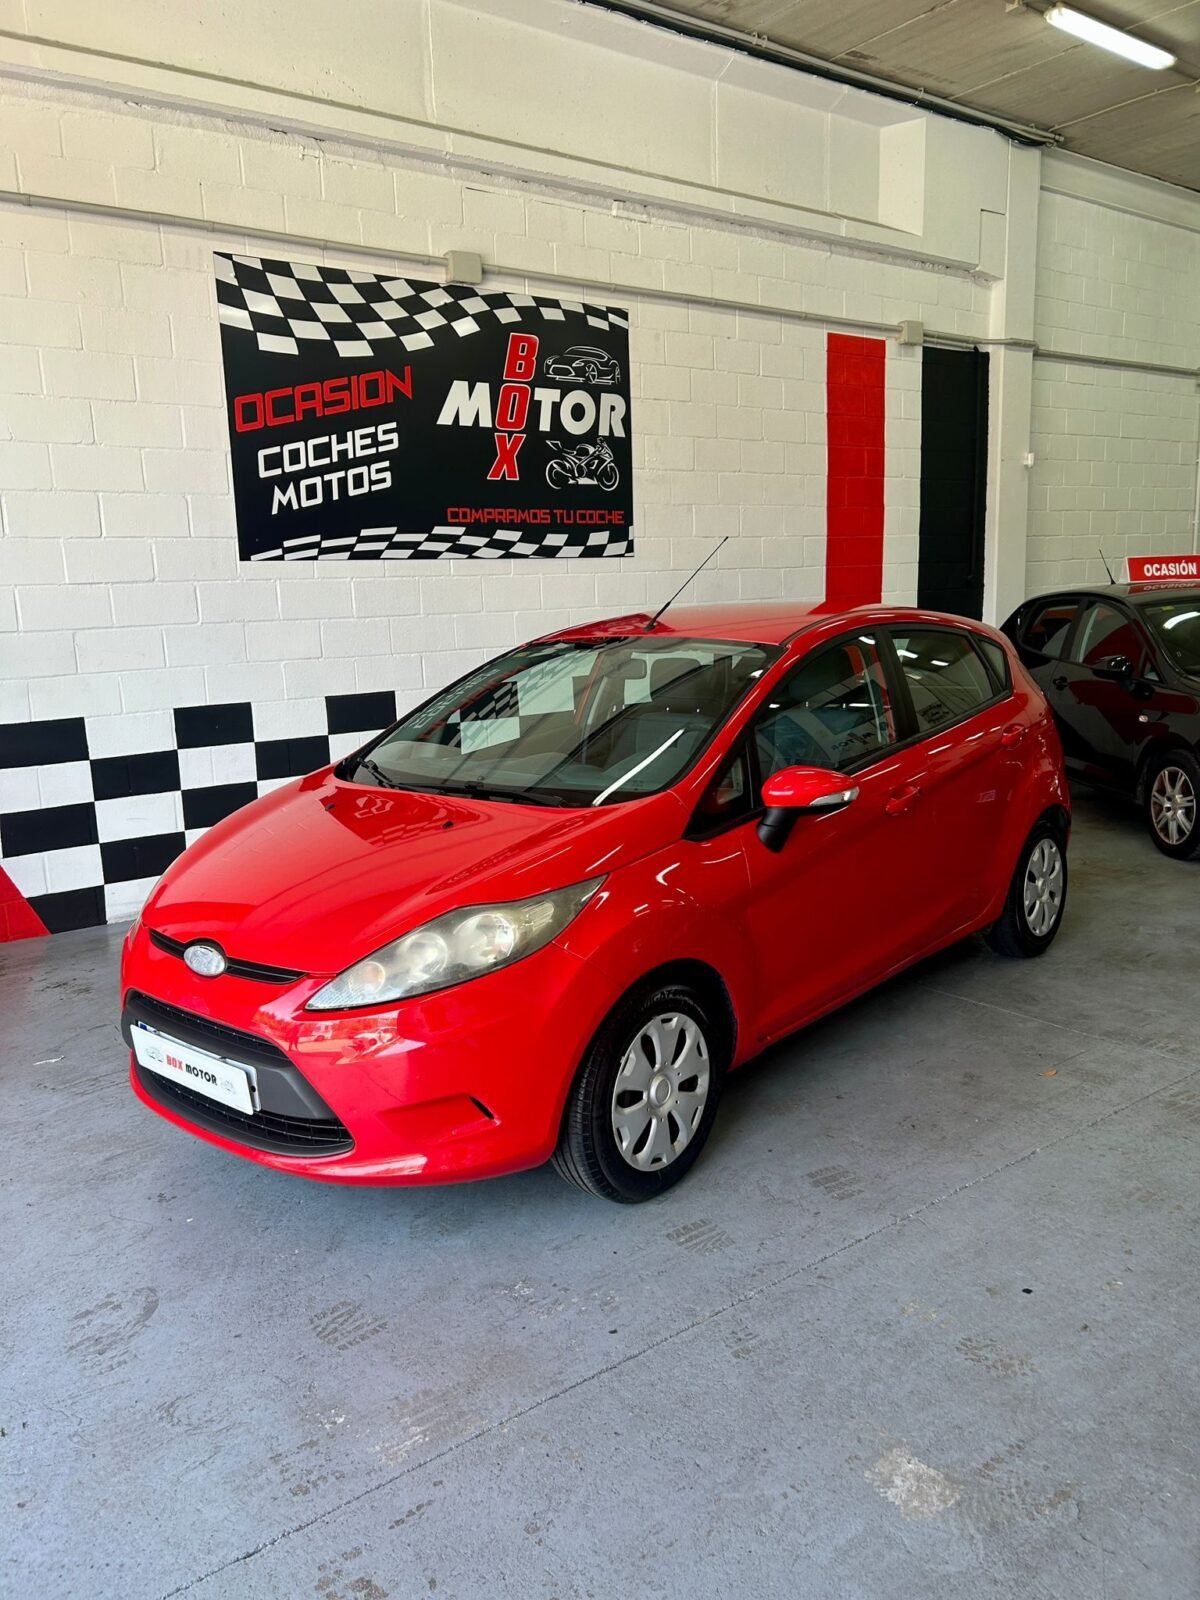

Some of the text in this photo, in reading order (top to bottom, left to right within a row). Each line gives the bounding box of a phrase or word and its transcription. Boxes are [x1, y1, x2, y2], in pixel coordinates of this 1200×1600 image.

[234, 365, 413, 433] OCASION
[257, 421, 399, 479] COCHES
[271, 461, 392, 515] MOTOS
[447, 507, 625, 525] COMPRAMOS TU COCHE
[1143, 559, 1197, 577] OCASIÓN
[166, 1055, 218, 1086] BOX MOTOR
